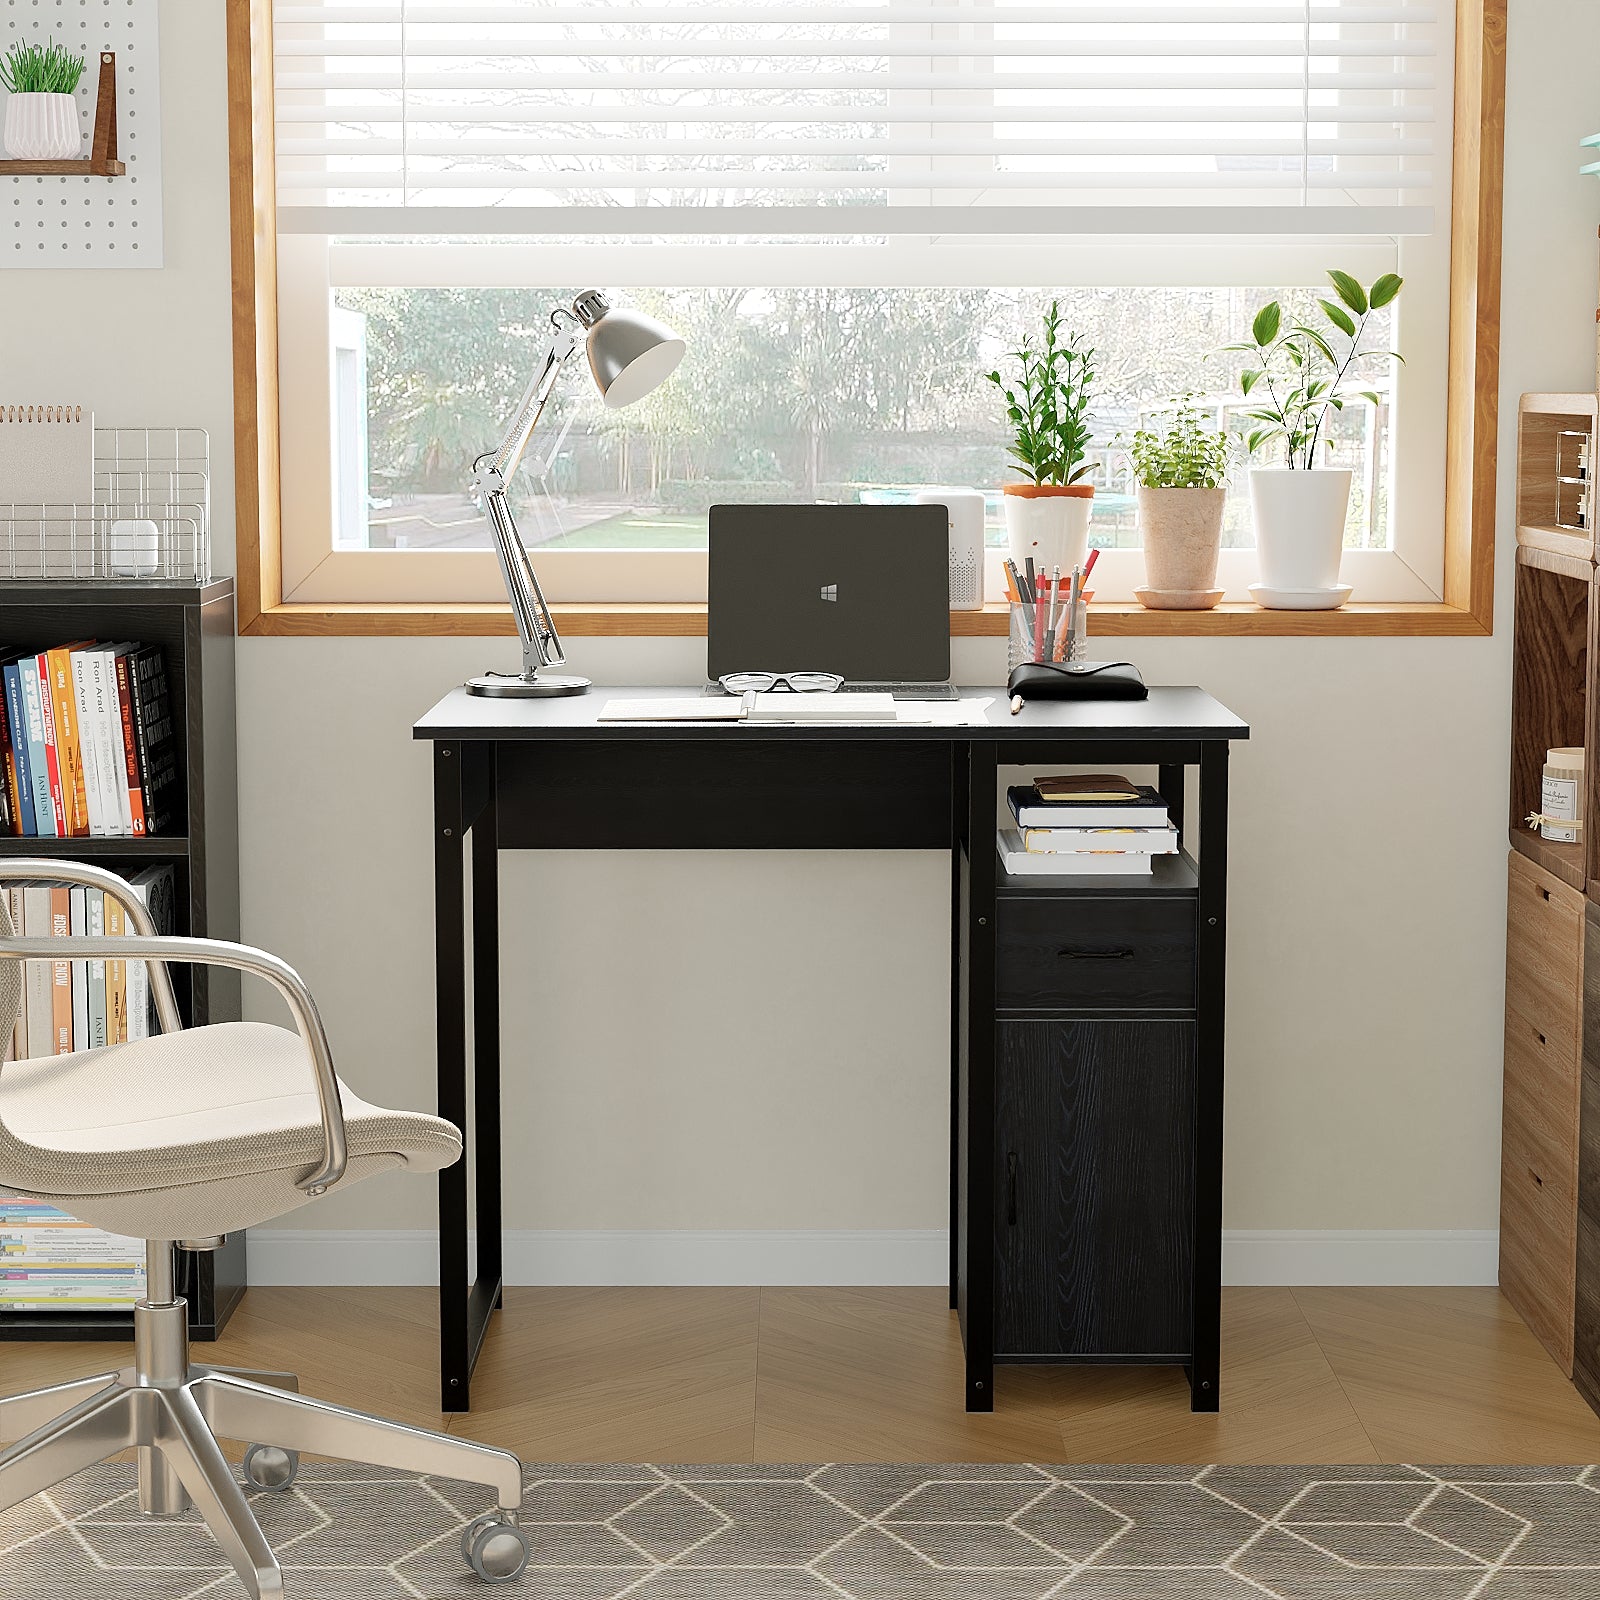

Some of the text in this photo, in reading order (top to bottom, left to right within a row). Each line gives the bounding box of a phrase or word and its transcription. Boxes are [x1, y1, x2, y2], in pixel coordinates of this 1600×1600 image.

[79, 686, 88, 713] Arad
[96, 687, 104, 713] Arad
[117, 663, 126, 691] DUMAS
[24, 669, 43, 743] STEAM
[40, 679, 54, 747] #DISRUPTMENOW
[121, 704, 135, 776] The Black Tulip
[38, 775, 49, 817] IAN HUNT
[53, 914, 68, 986] #DISENOW
